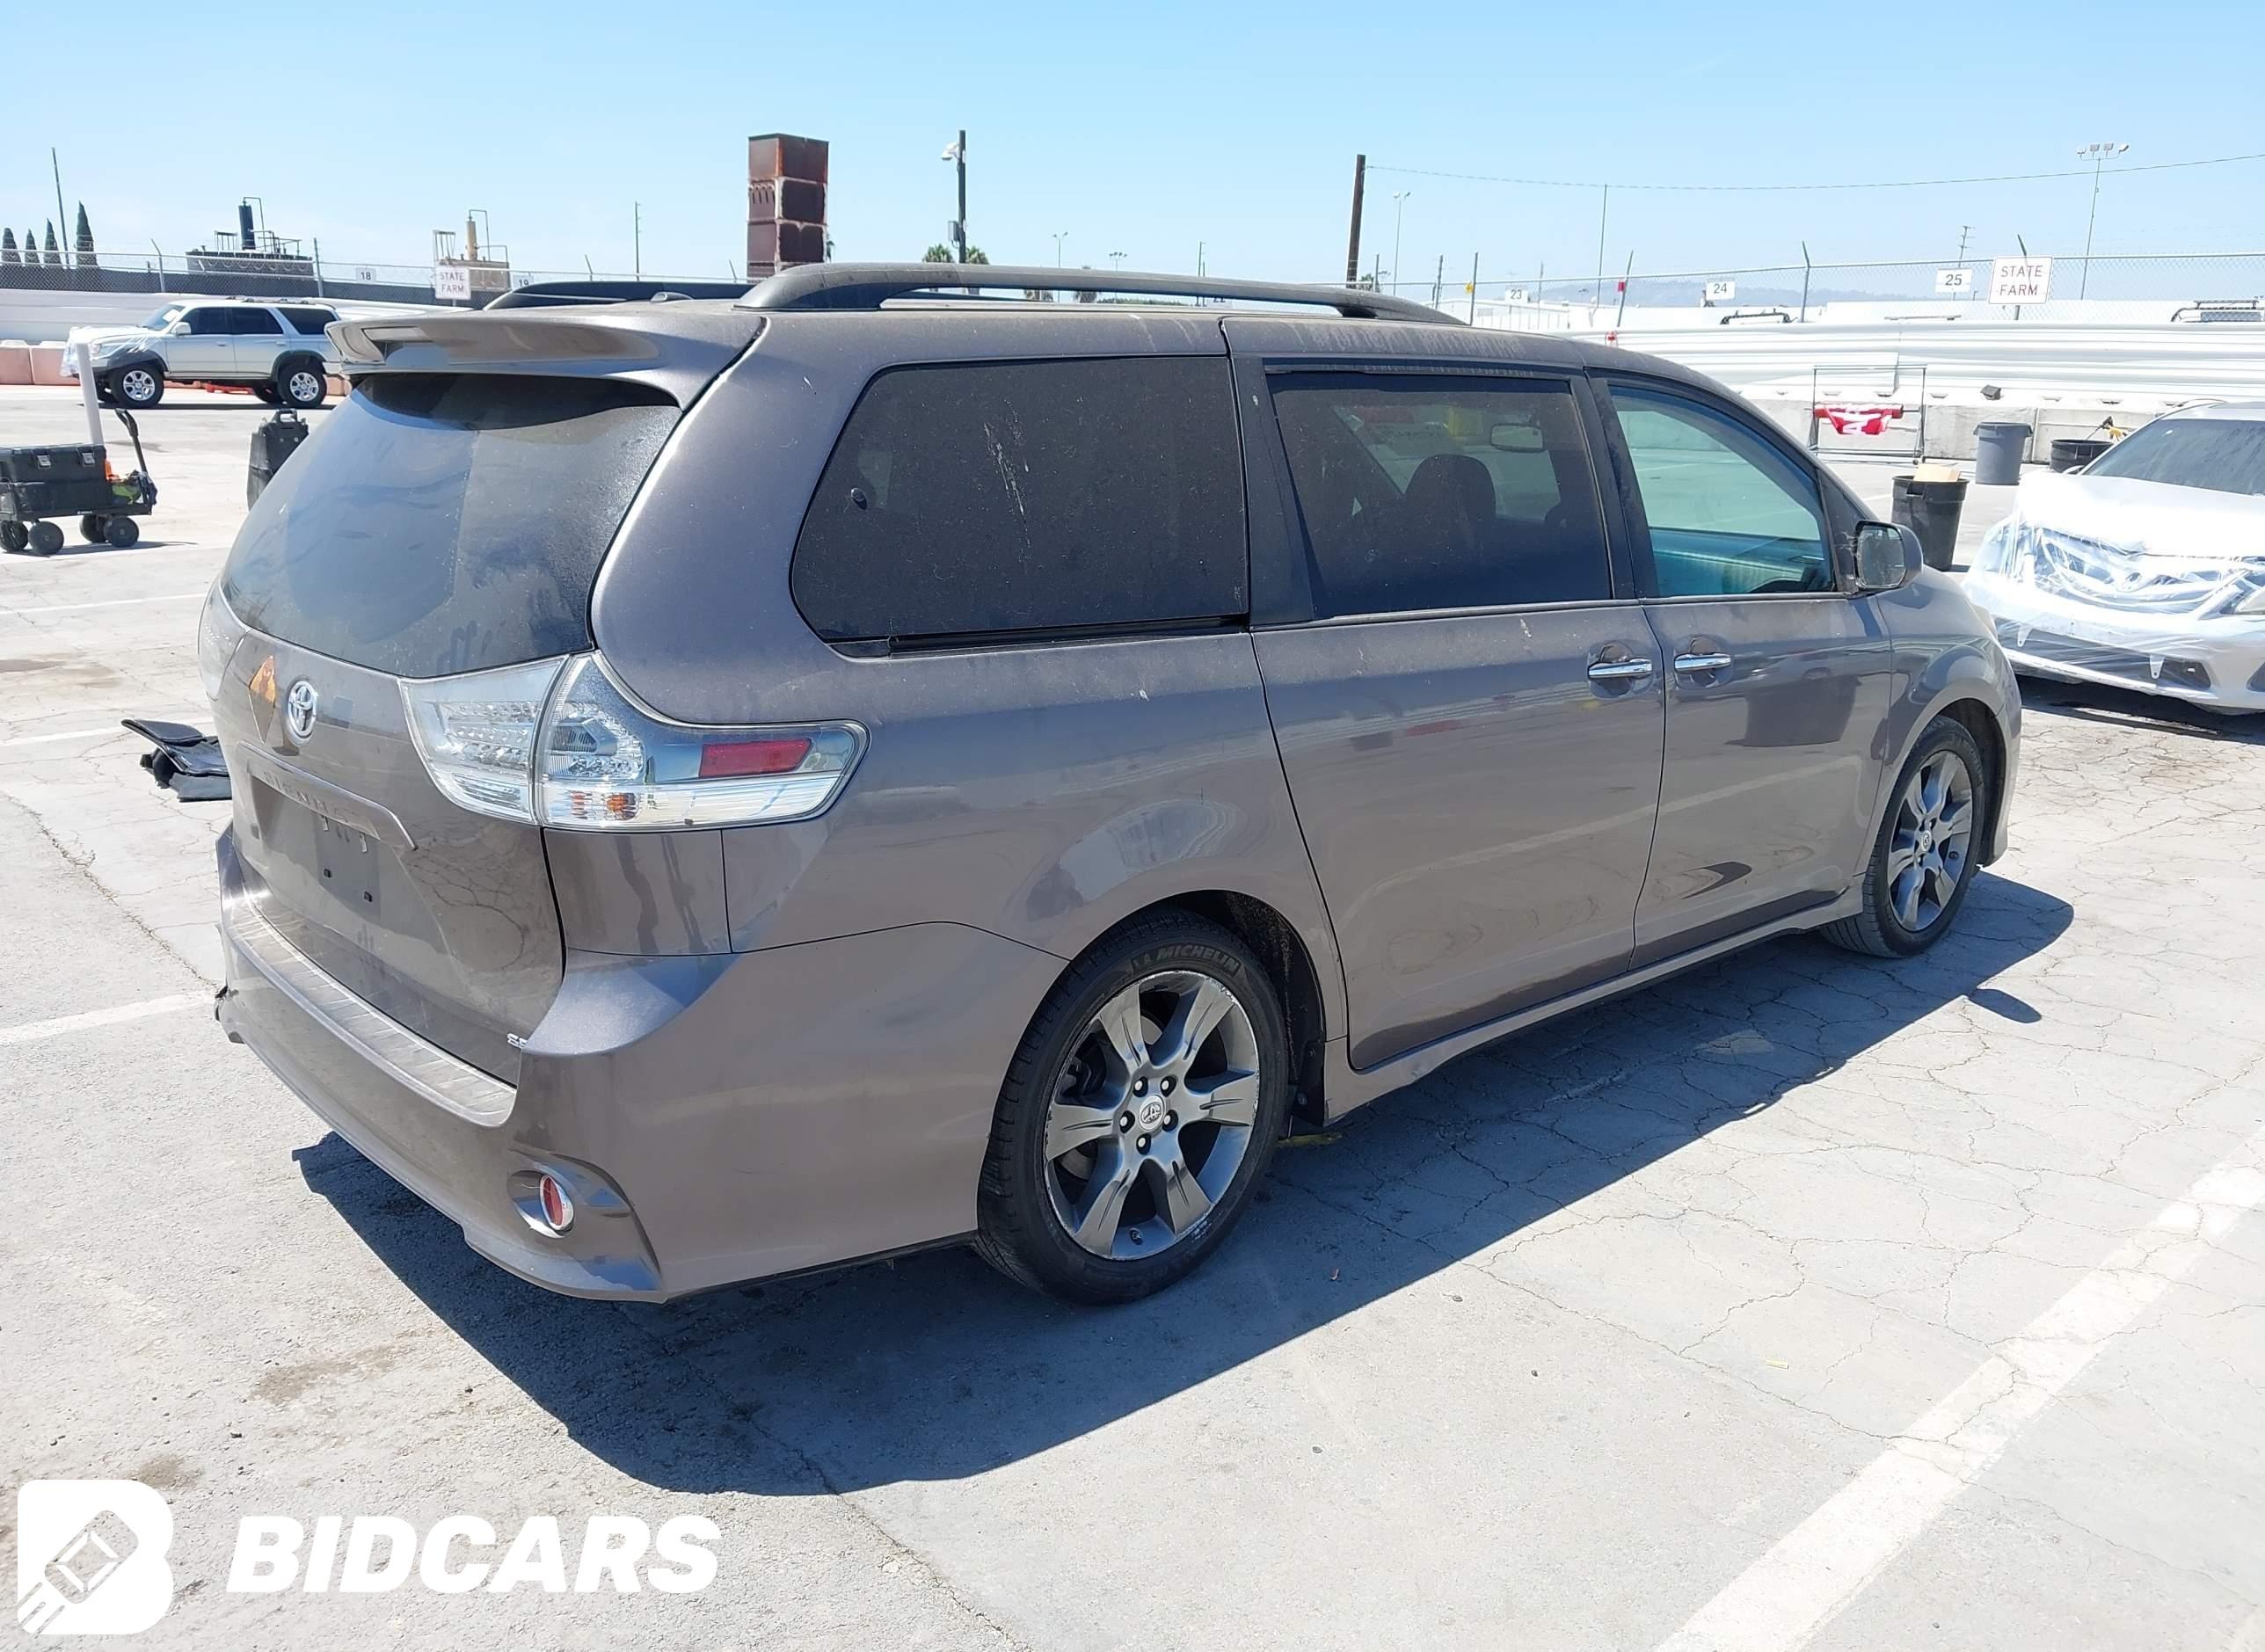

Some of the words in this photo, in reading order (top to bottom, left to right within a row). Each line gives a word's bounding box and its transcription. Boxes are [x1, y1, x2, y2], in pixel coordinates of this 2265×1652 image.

[361, 271, 371, 280] 18
[440, 272, 465, 281] STATE
[2000, 265, 2043, 278] STATE
[1944, 273, 1963, 286] 25
[441, 284, 465, 293] FARM
[1713, 282, 1728, 294] 24
[1999, 284, 2039, 296] FARM
[1510, 289, 1523, 300] 23
[1155, 943, 1241, 970] MICHELIN
